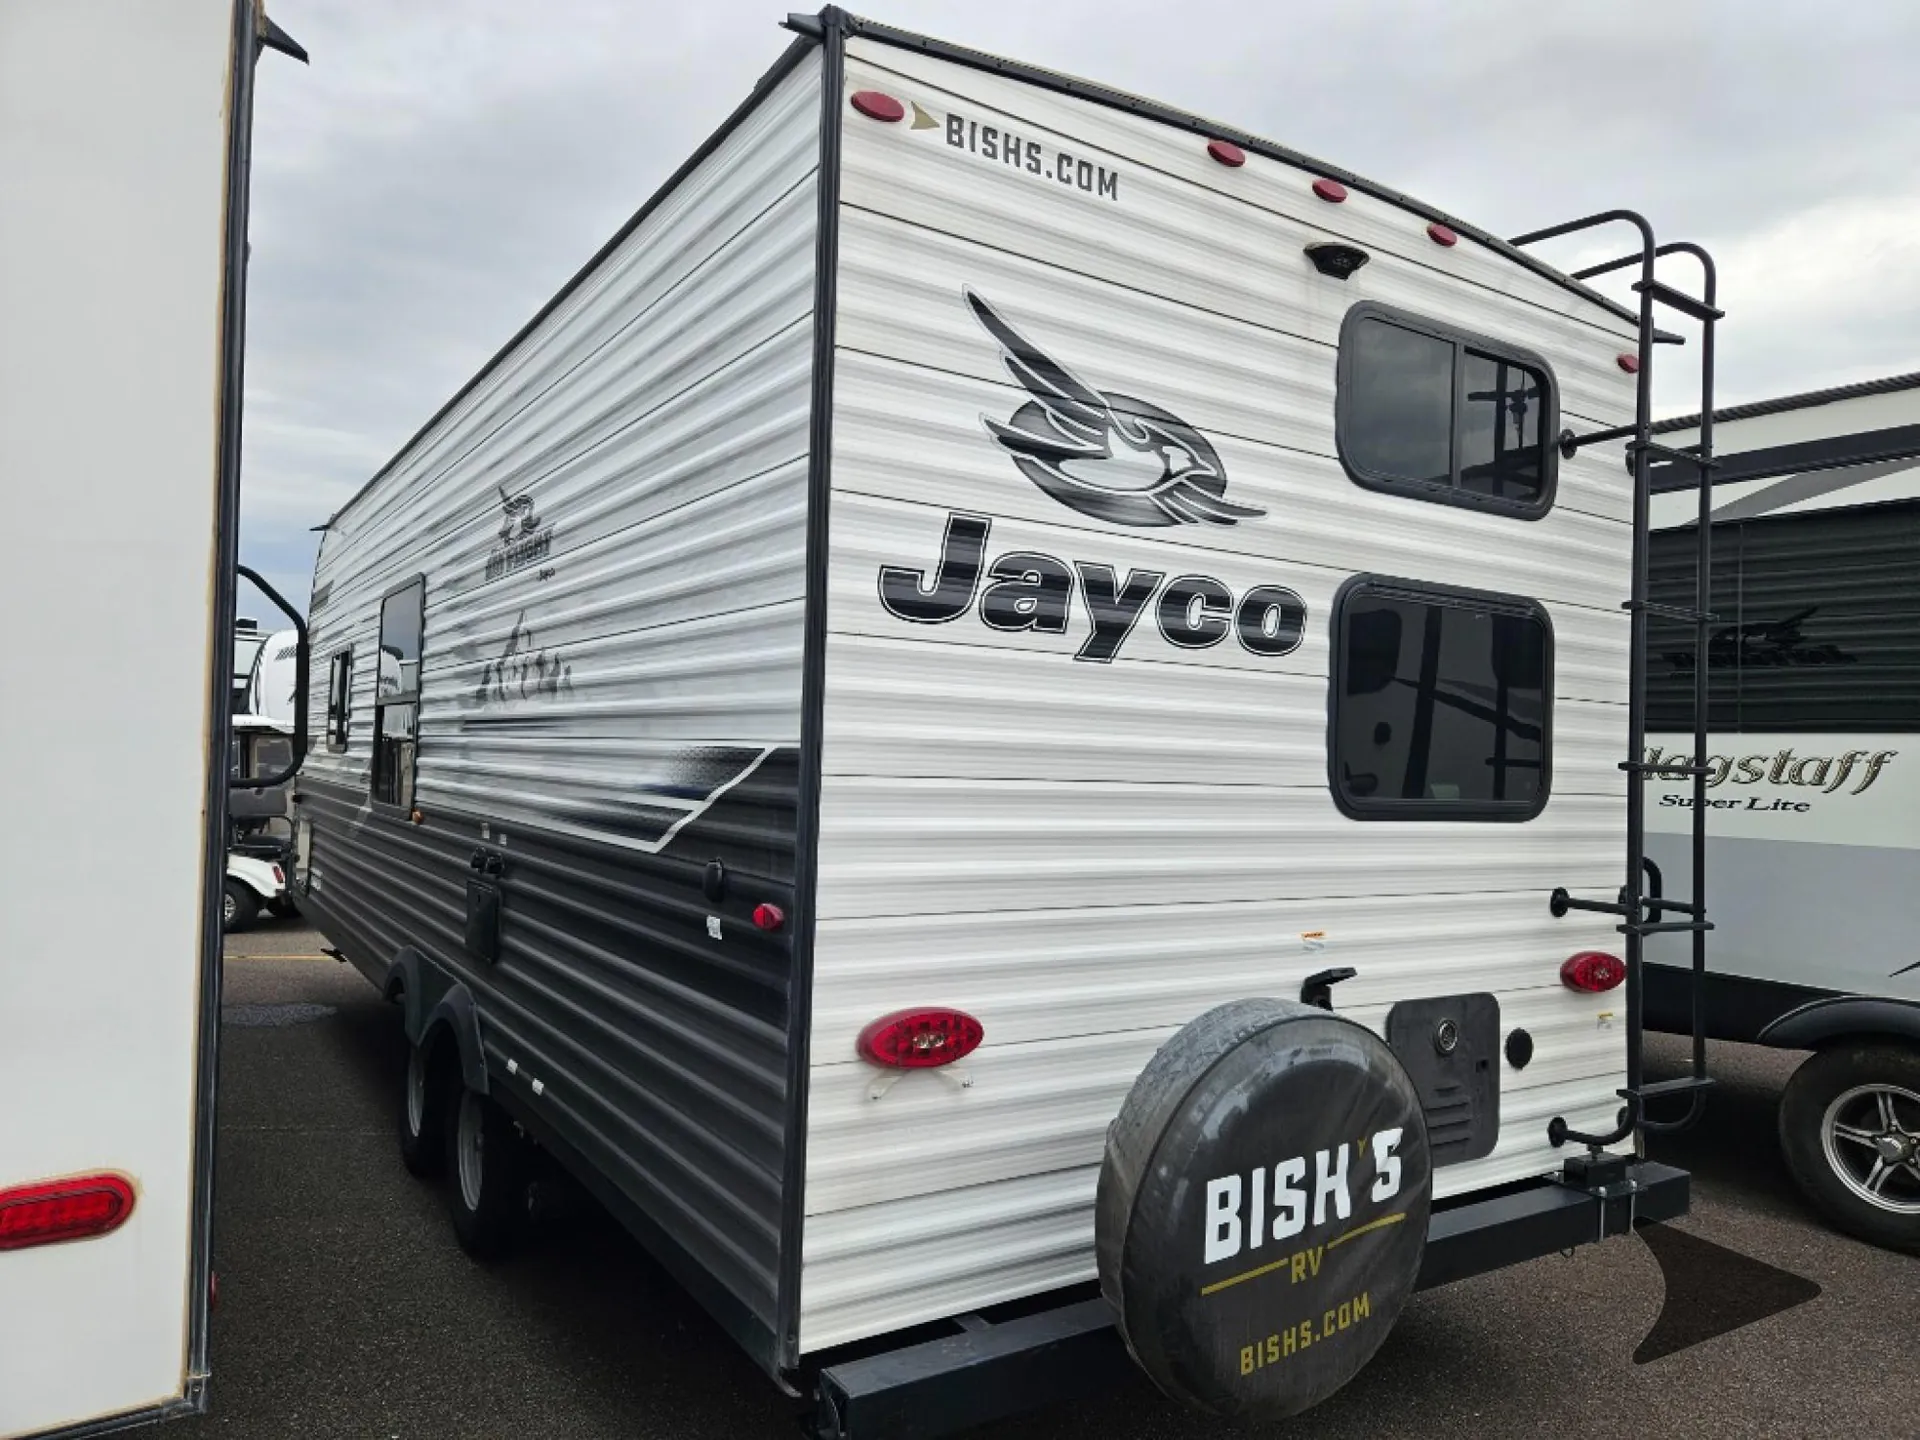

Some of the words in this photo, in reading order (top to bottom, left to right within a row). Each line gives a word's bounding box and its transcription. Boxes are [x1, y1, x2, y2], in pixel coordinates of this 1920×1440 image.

[945, 112, 1119, 202] BISHS.COM
[877, 511, 1308, 664] Jayco
[1643, 745, 1899, 796] lagstaff
[1744, 796, 1811, 813] Lite
[1290, 1245, 1325, 1286] RV
[1240, 1291, 1371, 1377] BISHS.COM
